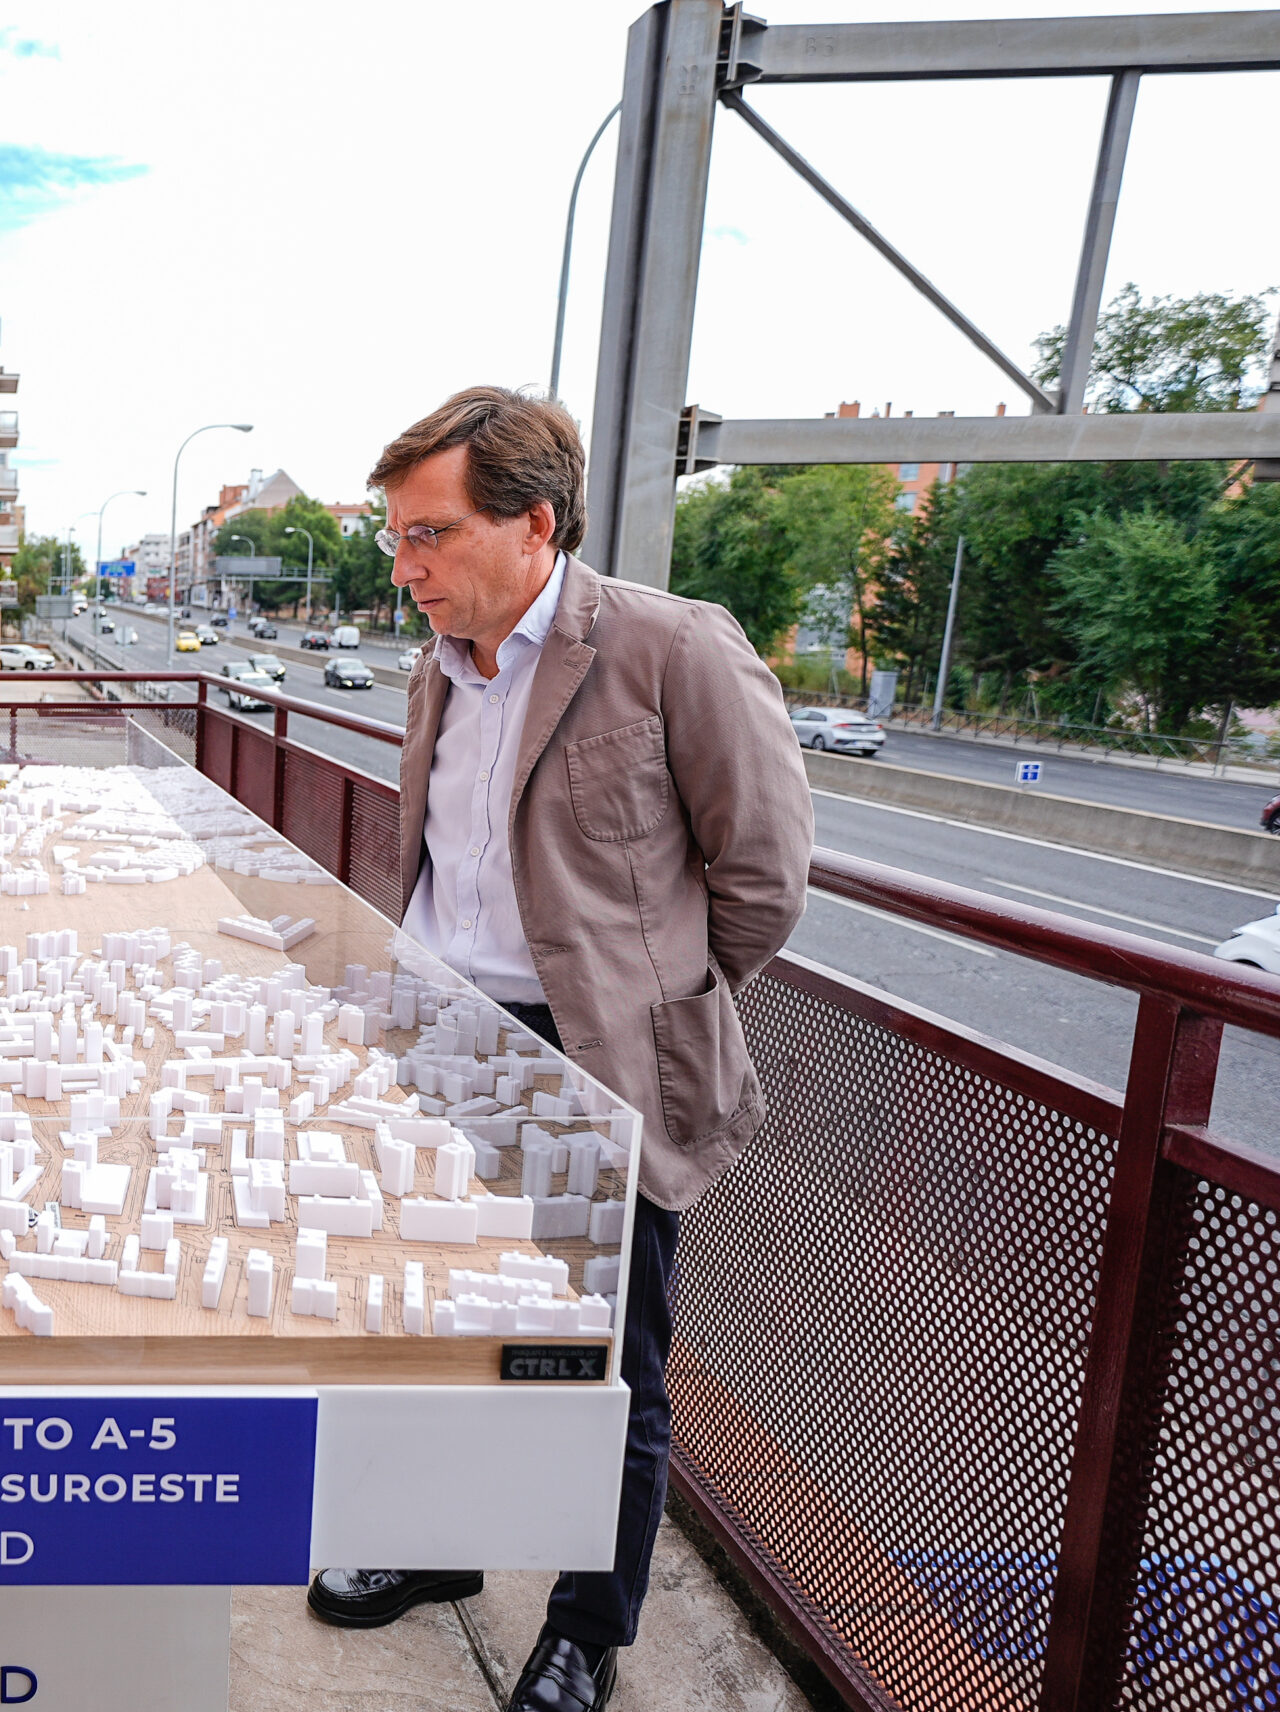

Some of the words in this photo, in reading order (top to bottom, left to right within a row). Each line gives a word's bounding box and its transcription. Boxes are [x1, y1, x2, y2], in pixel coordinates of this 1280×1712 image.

[509, 1358, 571, 1376] CTRL
[577, 1359, 597, 1376] X
[90, 1417, 177, 1450] A-5
[0, 1473, 240, 1503] SUROESTE
